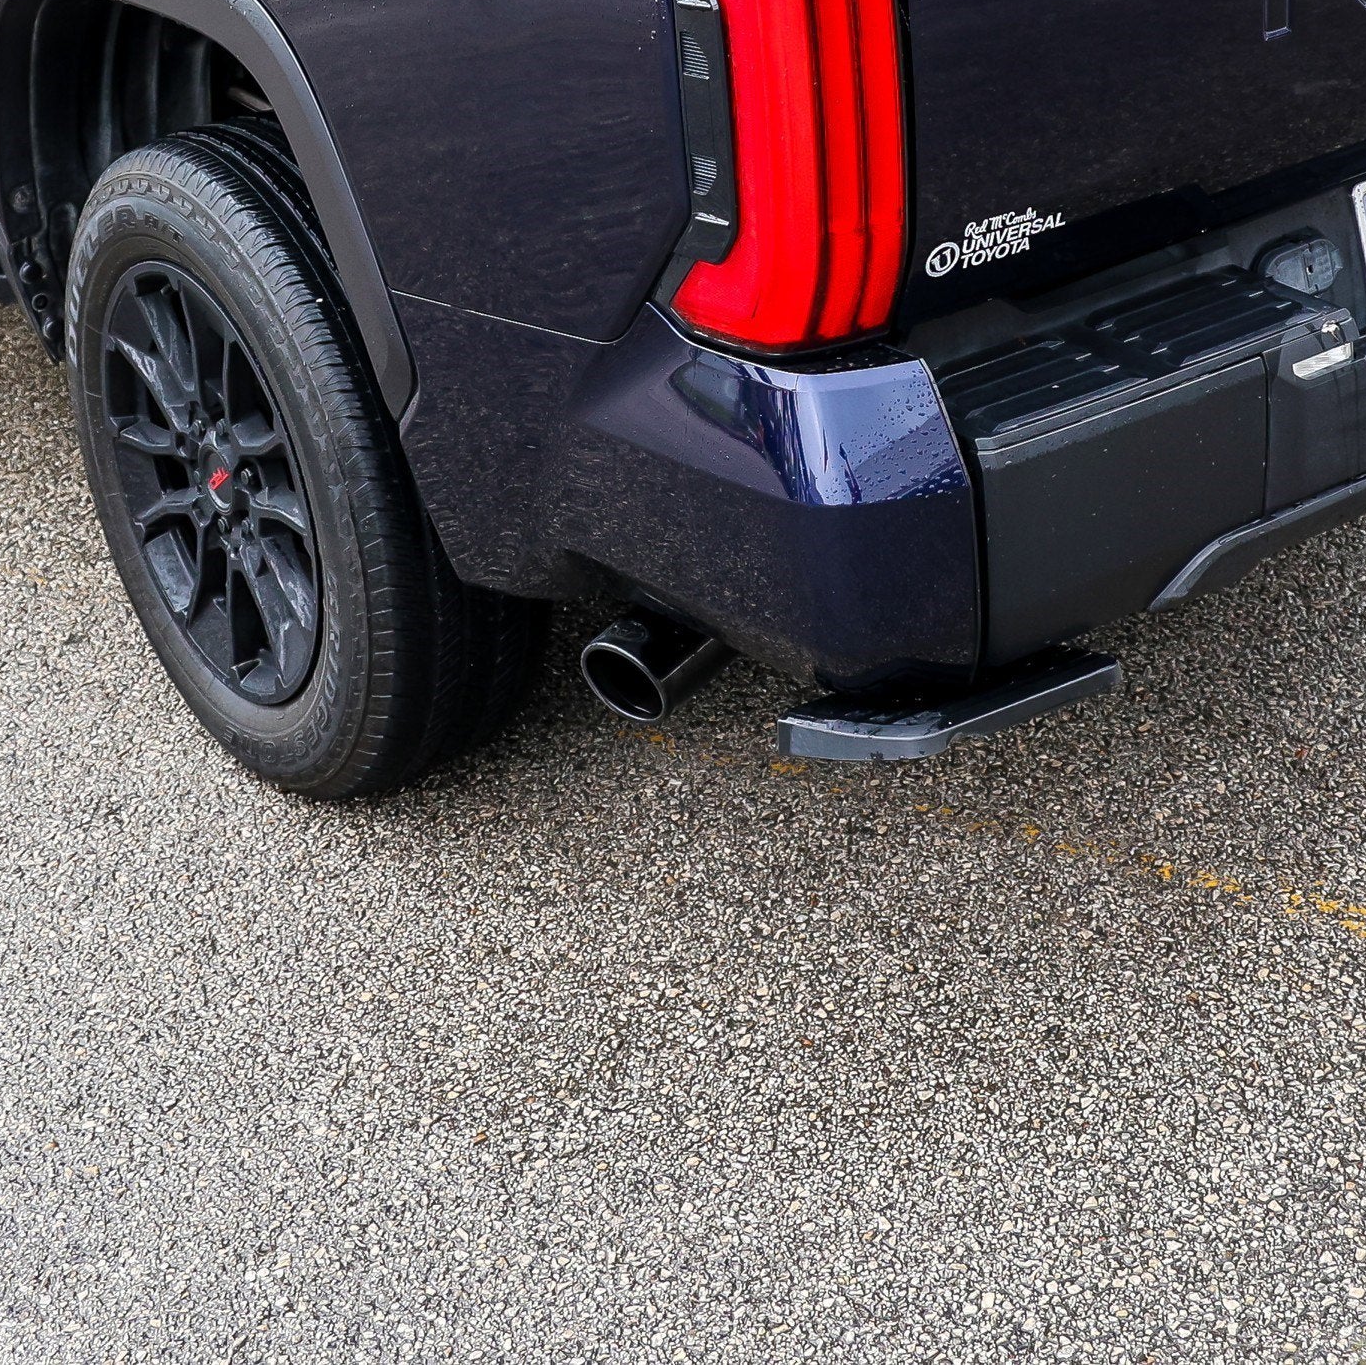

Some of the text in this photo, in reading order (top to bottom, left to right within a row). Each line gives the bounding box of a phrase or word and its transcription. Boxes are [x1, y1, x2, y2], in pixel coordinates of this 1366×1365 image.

[962, 212, 1066, 254] UNIVERSAL
[964, 219, 987, 239] Red
[960, 237, 1030, 269] TOYOTA
[68, 204, 138, 368] DUELER
[222, 570, 341, 763] BRIDGESTONE
